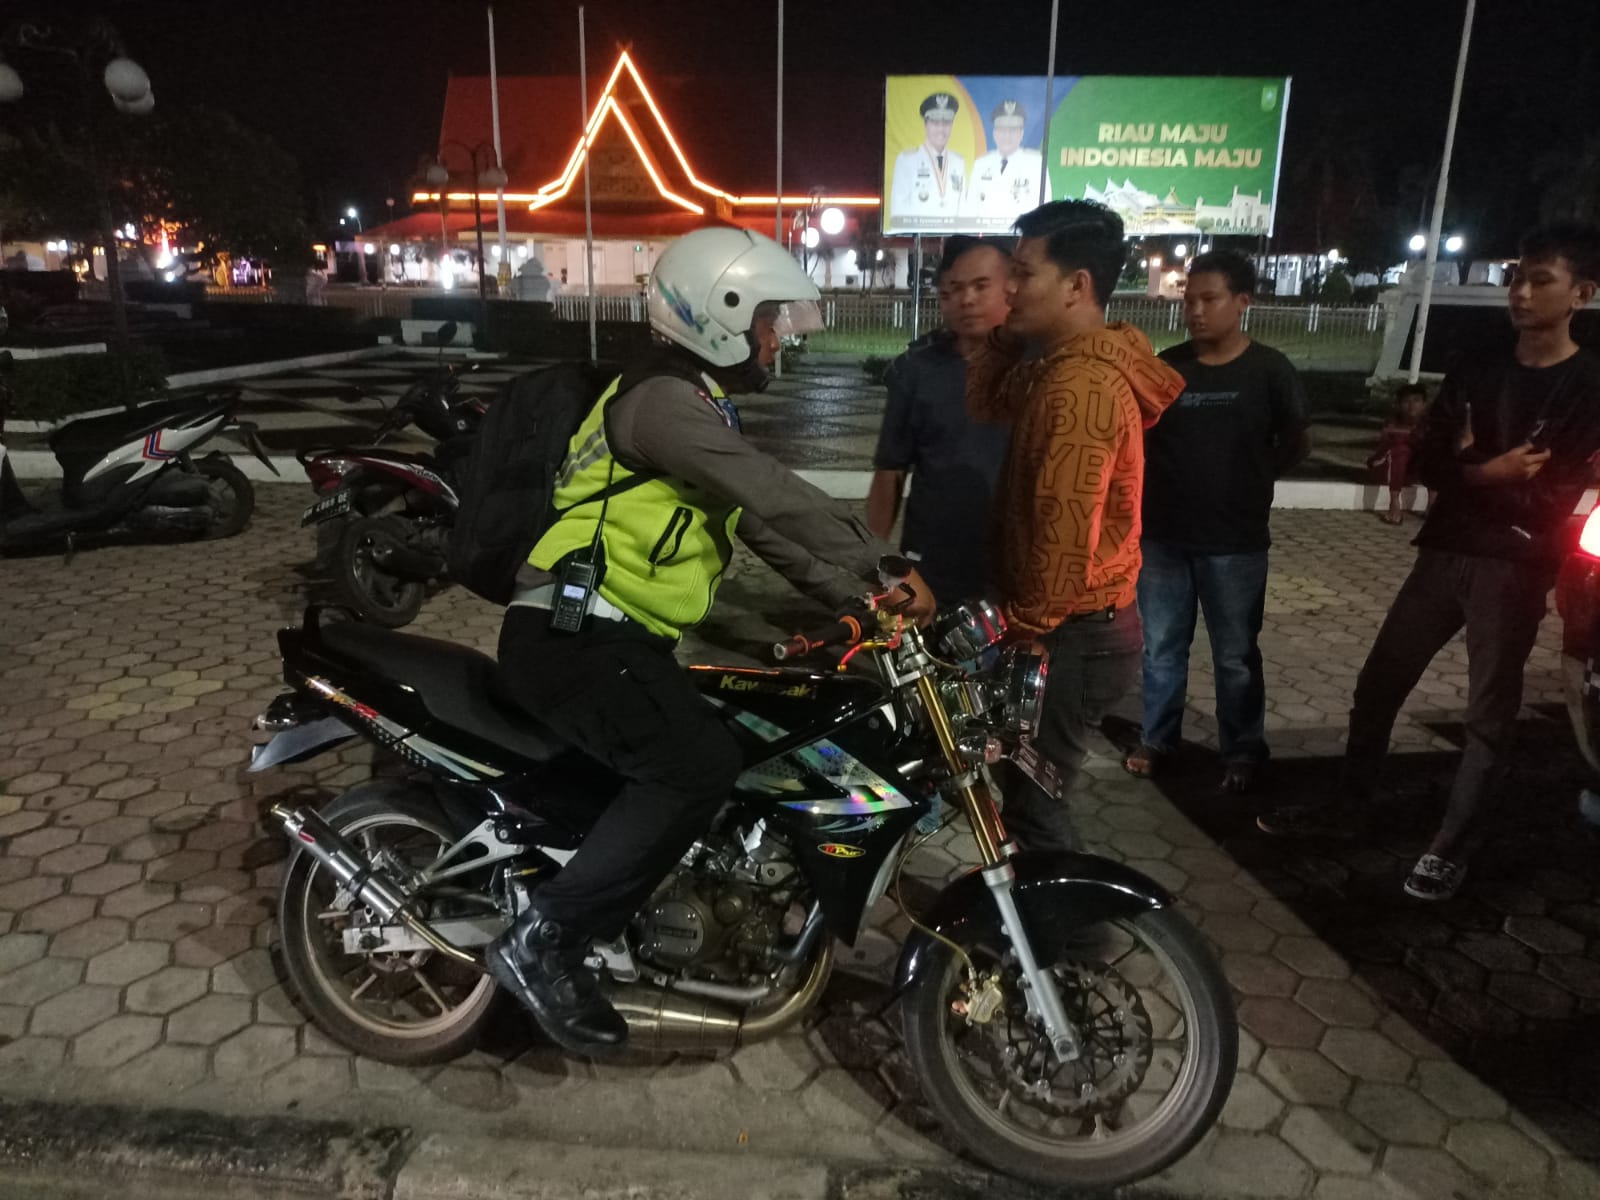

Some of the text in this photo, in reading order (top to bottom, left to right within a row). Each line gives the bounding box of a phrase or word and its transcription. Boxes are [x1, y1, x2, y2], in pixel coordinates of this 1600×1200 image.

[1098, 123, 1228, 145] RIAU MAJU
[1060, 147, 1263, 169] INDONESIA MAJU
[720, 674, 817, 699] Kawaki
